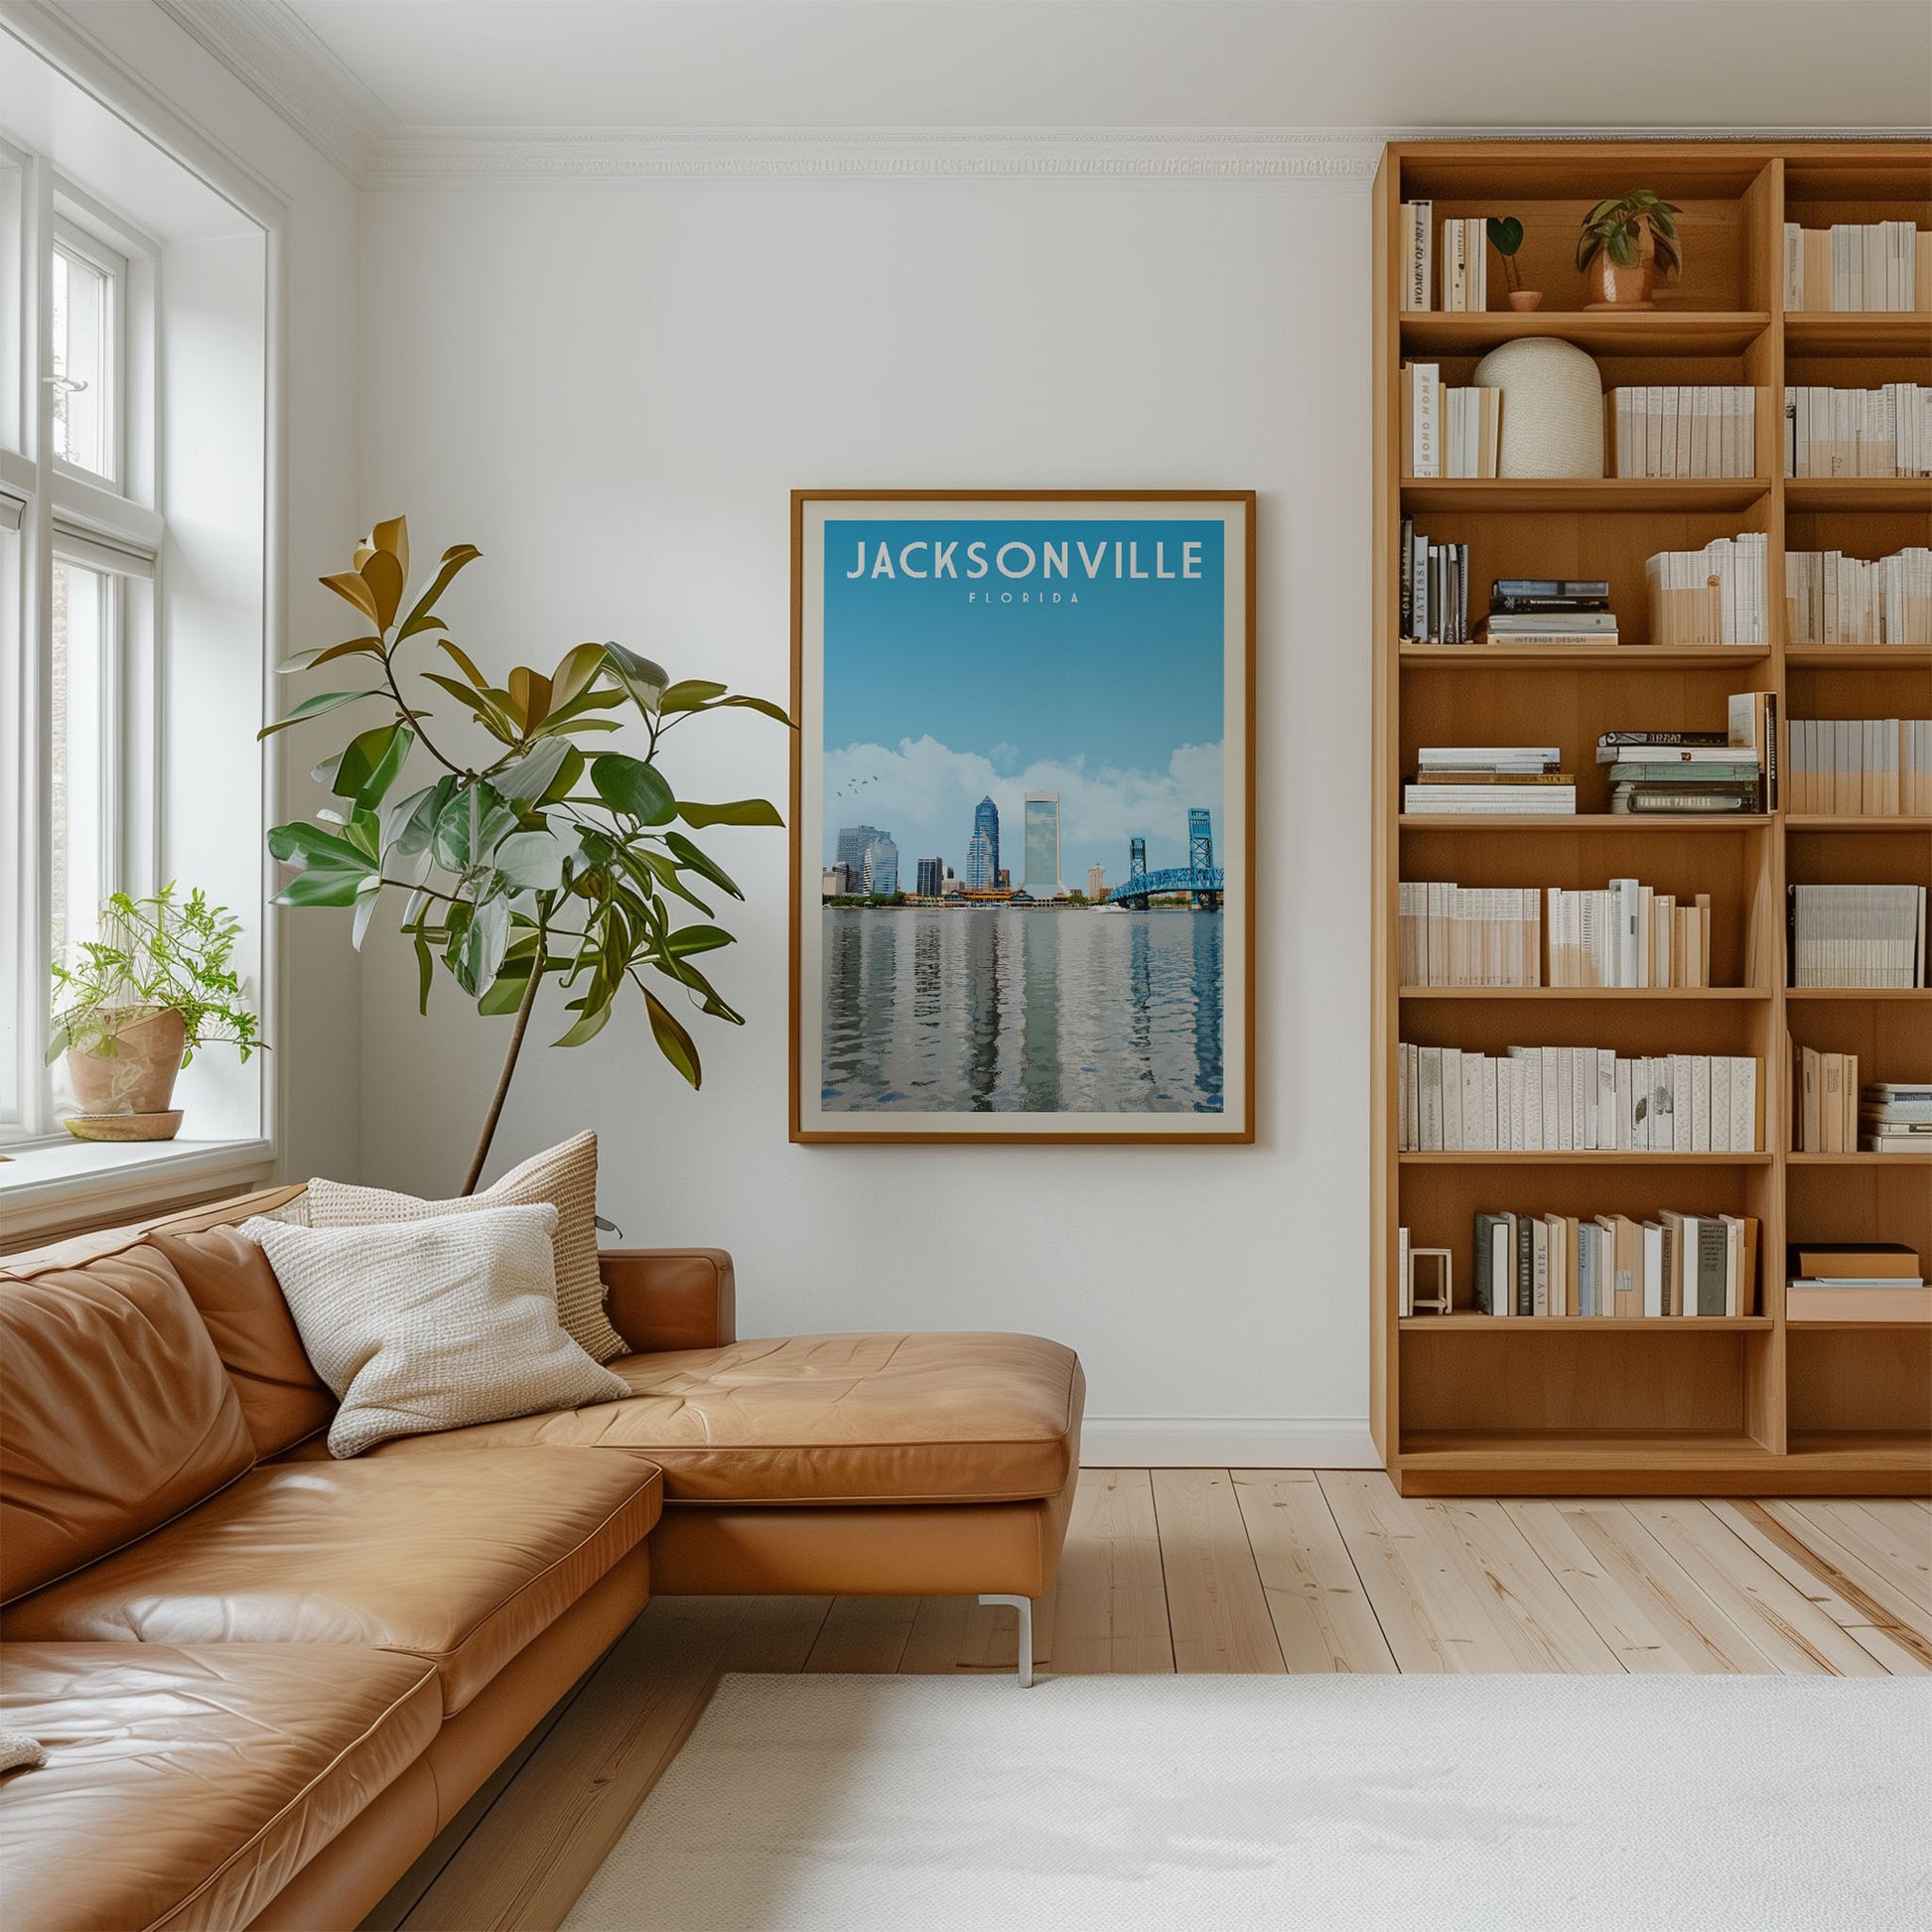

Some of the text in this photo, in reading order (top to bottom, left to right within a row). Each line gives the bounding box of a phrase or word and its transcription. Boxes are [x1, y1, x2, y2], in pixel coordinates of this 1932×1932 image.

[1415, 245, 1424, 260] OF
[1415, 262, 1424, 305] WOMEN
[1422, 374, 1431, 415] HOME
[1422, 422, 1431, 462] BOHO
[847, 541, 1202, 579] JACKSONVILLE
[969, 592, 1078, 603] FLORIDA
[1639, 797, 1711, 807] FAMOUS PAINTERS
